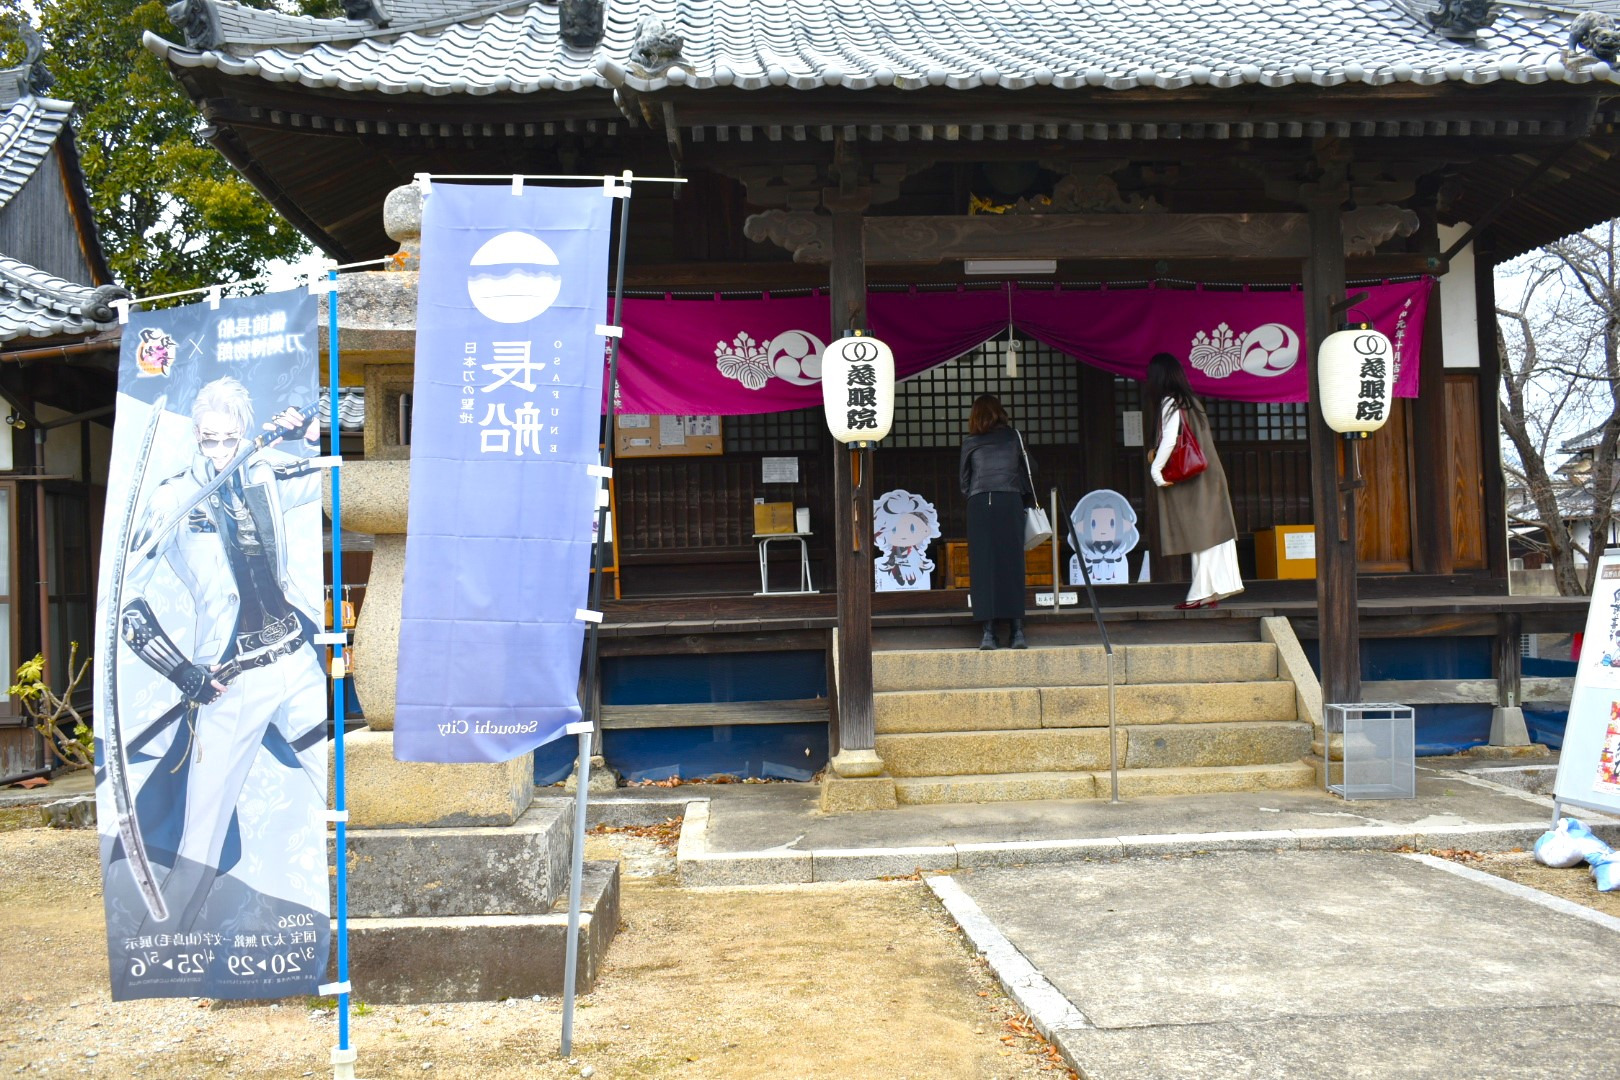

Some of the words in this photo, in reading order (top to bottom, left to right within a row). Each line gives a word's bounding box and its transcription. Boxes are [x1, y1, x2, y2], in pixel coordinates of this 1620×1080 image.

[846, 364, 878, 430] 慈眼院
[1355, 358, 1386, 421] 慈眼院
